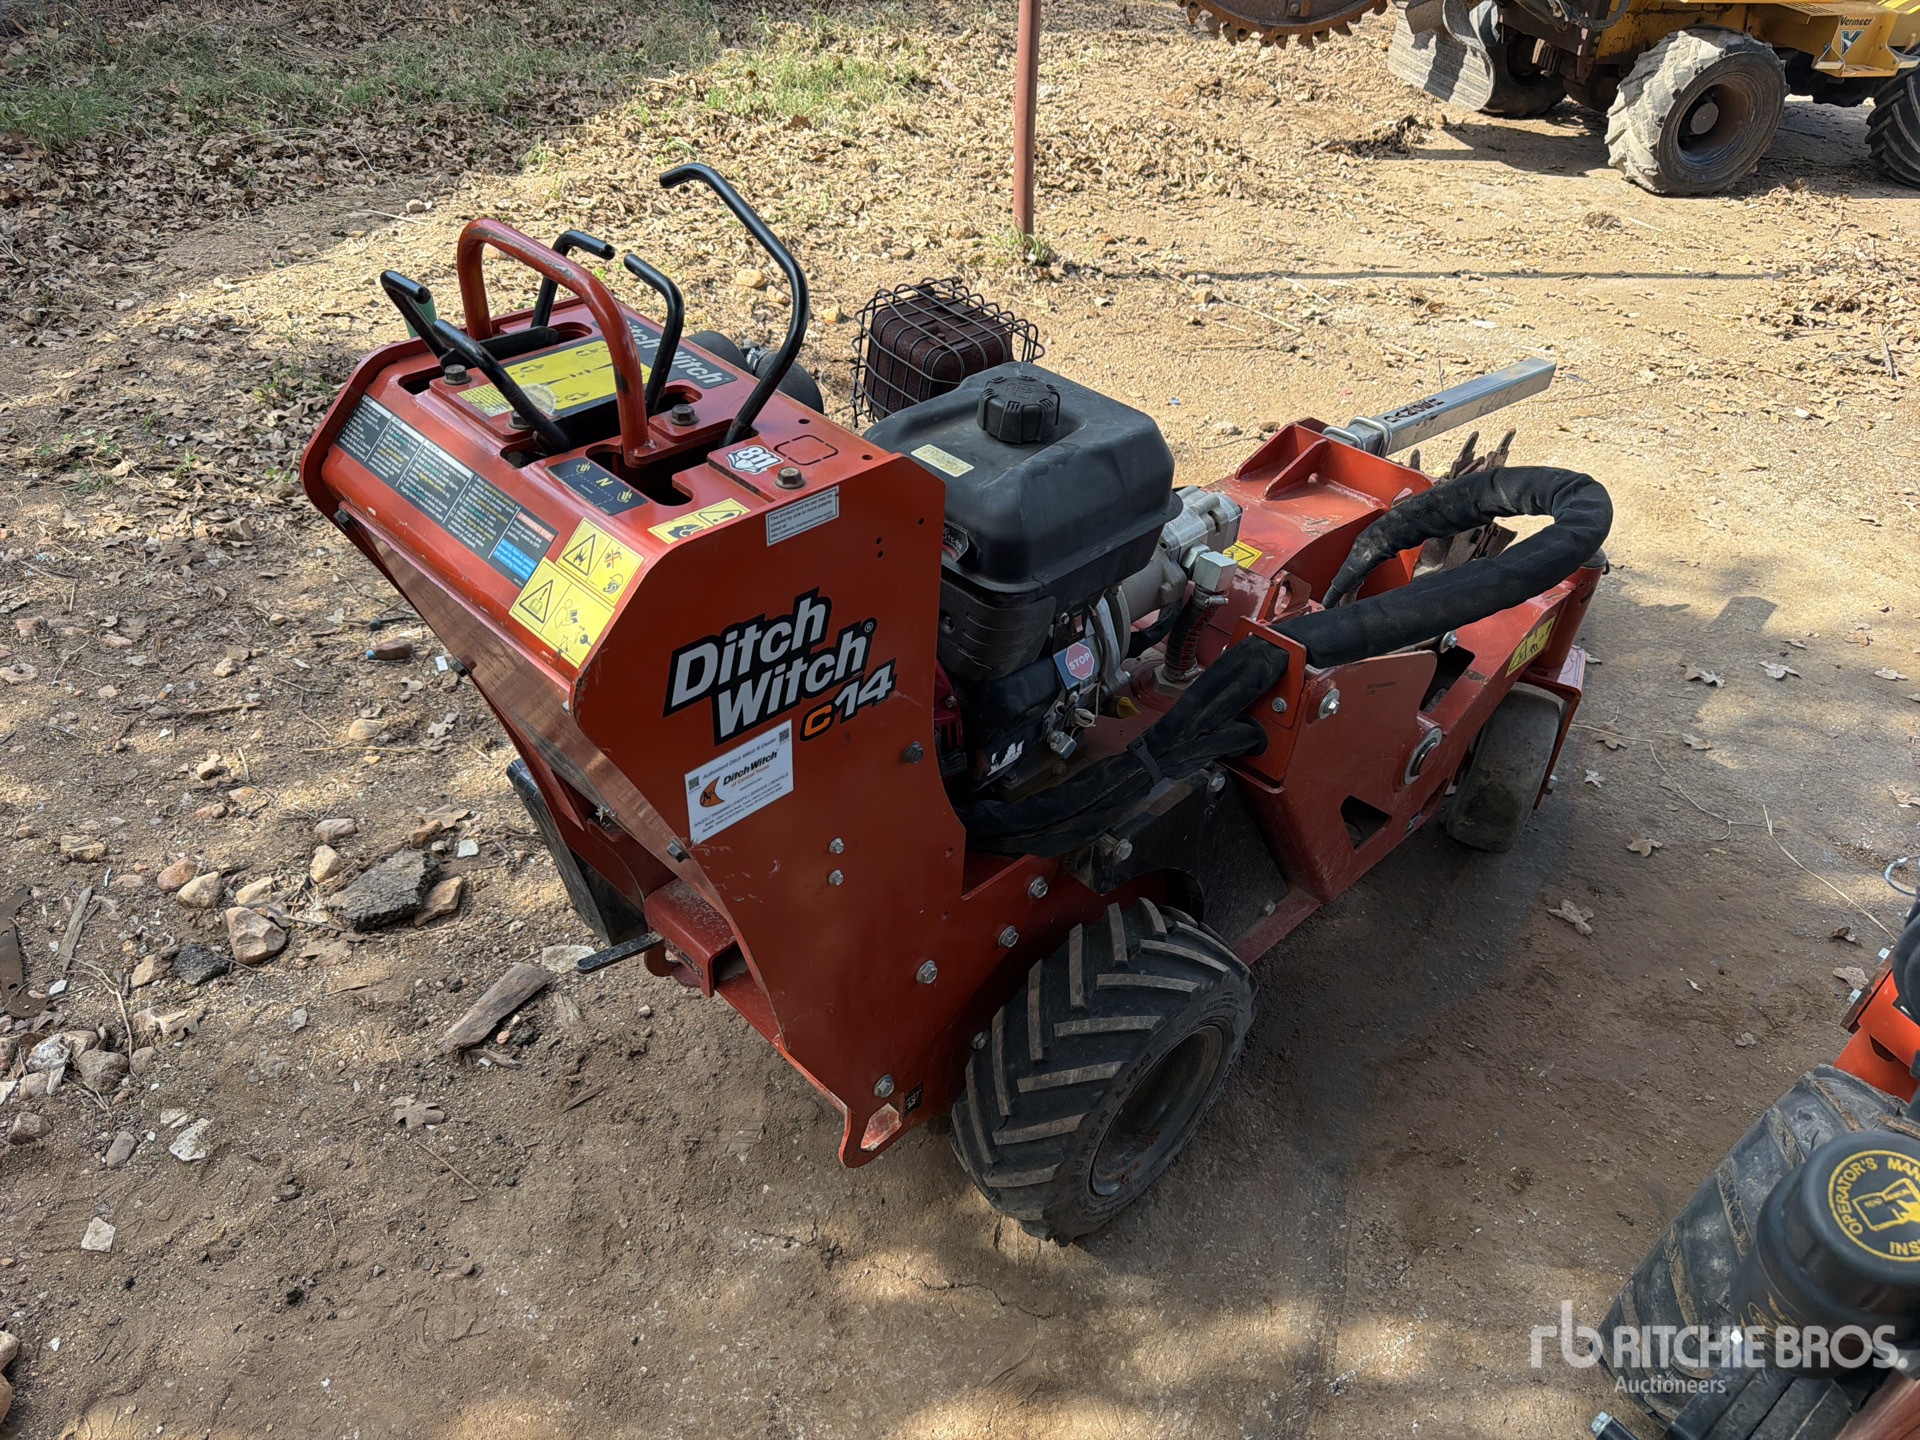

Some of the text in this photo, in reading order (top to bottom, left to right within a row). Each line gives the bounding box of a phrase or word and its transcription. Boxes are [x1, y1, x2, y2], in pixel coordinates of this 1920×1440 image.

[1840, 16, 1872, 26] Vermeer
[736, 446, 780, 469] 811
[671, 597, 826, 708] Ditch
[1068, 652, 1091, 670] STOP
[1836, 1157, 1878, 1235] OPERATOR'S
[1890, 1239, 1920, 1256] INS
